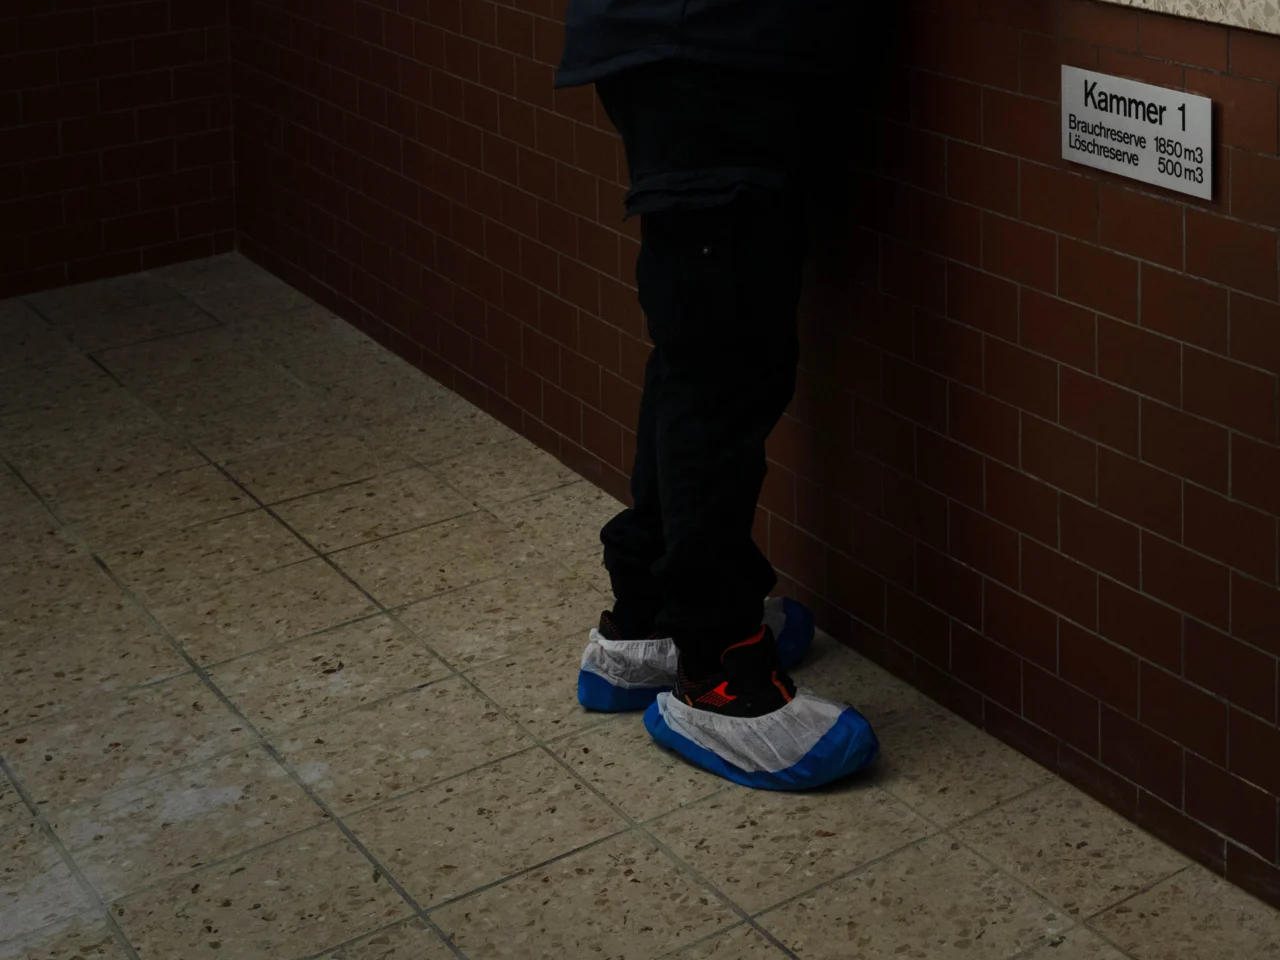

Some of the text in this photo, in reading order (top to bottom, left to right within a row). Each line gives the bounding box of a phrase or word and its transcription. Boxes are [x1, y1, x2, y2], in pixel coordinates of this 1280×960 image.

[1084, 79, 1186, 132] Kammer 1
[1068, 113, 1147, 149] Brauchreserve
[1068, 132, 1140, 167] Löschreserve
